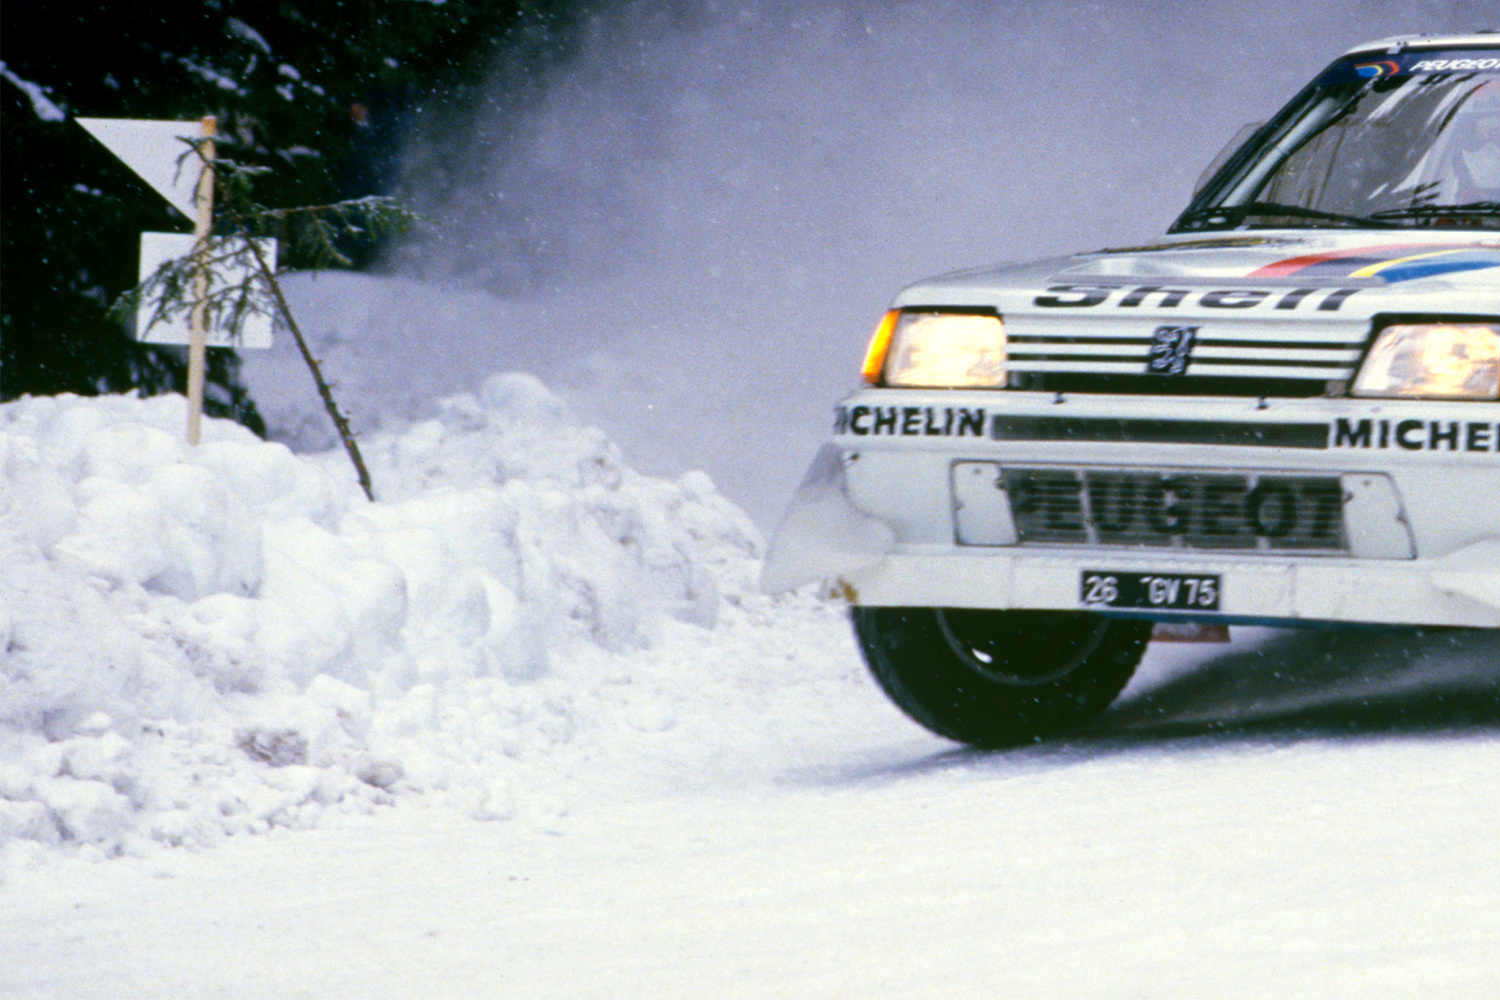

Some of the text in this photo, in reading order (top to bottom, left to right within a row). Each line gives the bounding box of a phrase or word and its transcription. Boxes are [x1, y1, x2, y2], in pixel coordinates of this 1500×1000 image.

[1034, 285, 1362, 311] Shell
[1012, 477, 1343, 539] PEUGEOT
[1084, 575, 1118, 603] 26
[1183, 578, 1216, 606] 75
